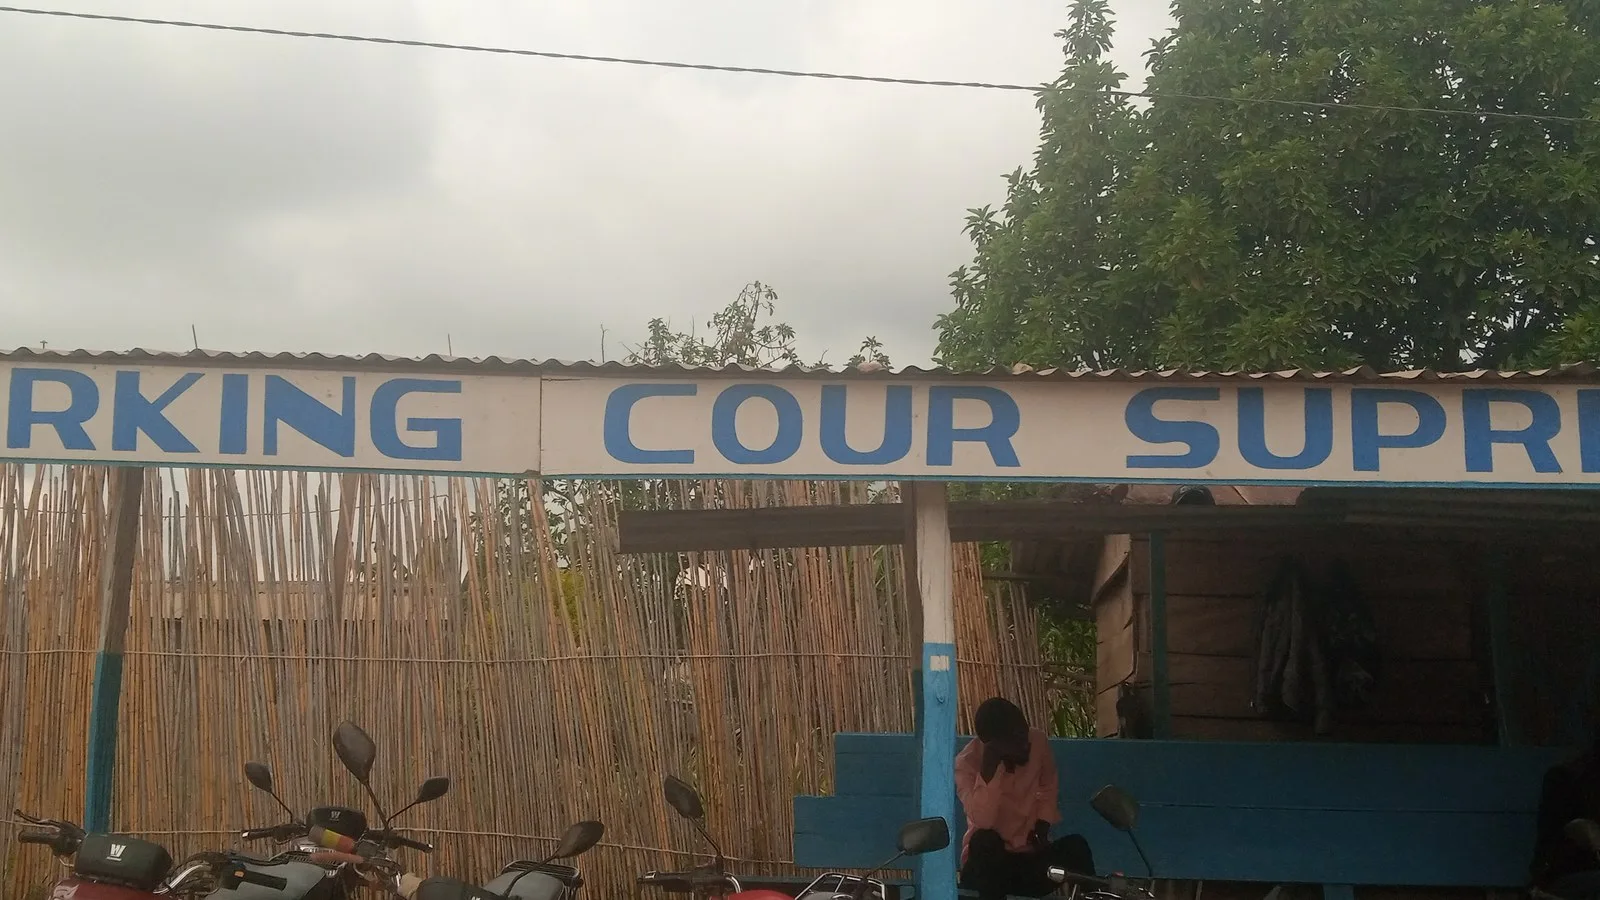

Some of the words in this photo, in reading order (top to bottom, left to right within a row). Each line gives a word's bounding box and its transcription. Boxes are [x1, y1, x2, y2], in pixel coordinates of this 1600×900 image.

[7, 367, 462, 462] RKING
[603, 383, 1020, 467] COUR
[1125, 386, 1600, 473] SUPR
